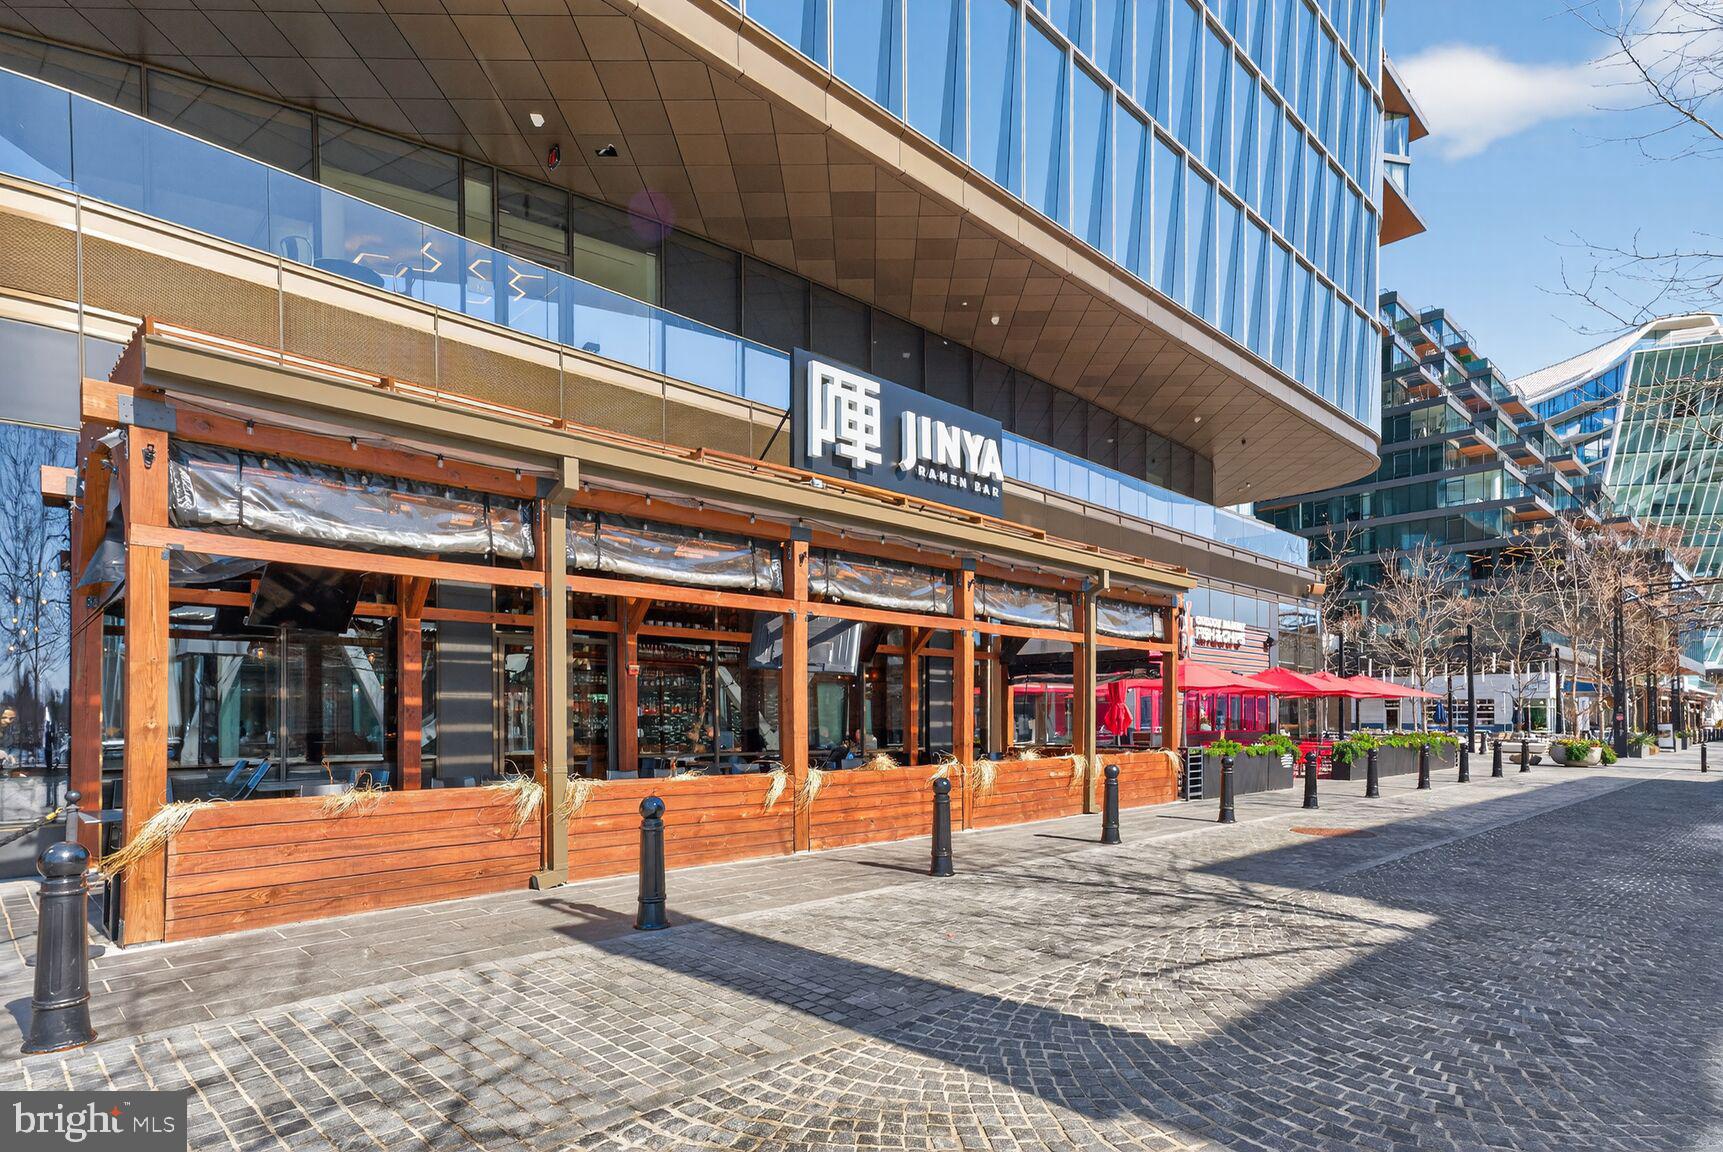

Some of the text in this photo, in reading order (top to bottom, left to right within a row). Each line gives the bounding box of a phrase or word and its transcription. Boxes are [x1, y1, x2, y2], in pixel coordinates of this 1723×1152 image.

[899, 411, 1004, 482] JINYA
[918, 465, 999, 498] RAMEN BAR
